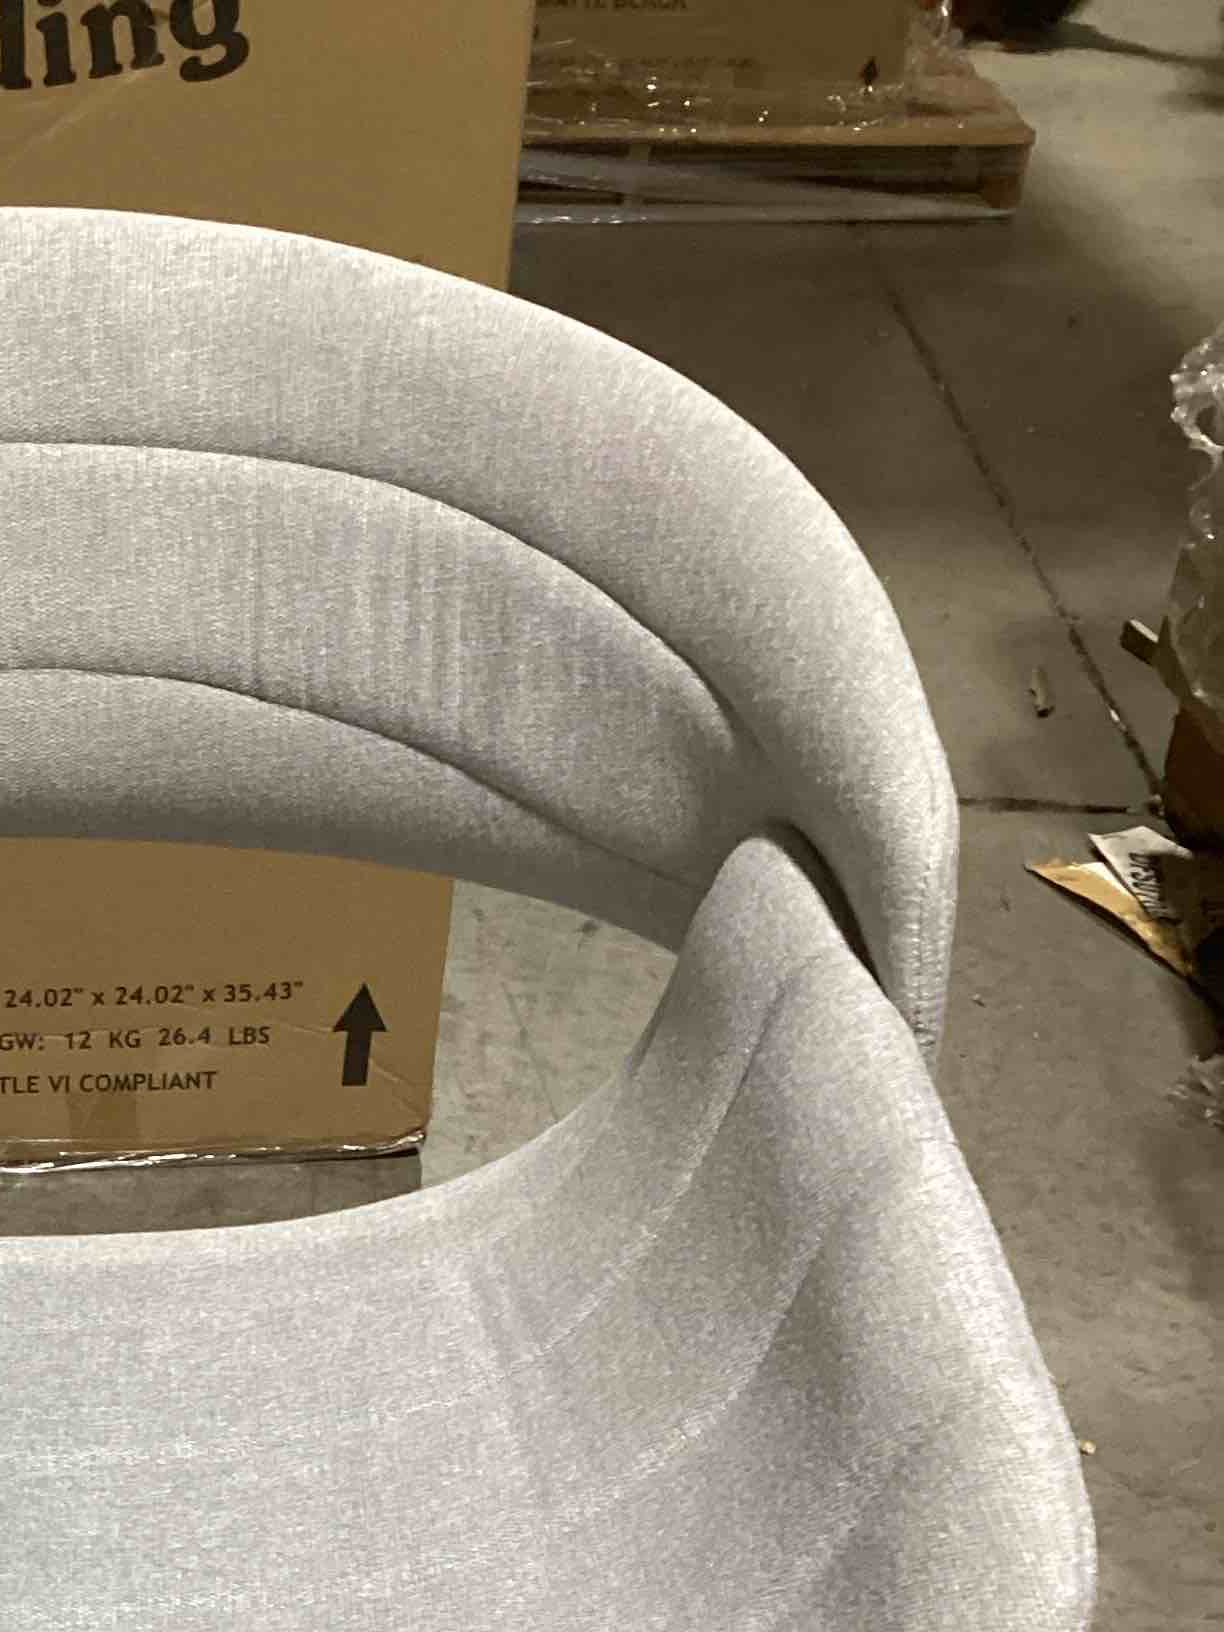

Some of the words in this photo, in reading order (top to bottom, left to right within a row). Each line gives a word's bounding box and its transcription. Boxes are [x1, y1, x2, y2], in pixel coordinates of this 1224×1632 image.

[4, 987, 84, 1008] 24.02"
[91, 990, 105, 1006] x
[115, 984, 195, 1005] 24.02"
[202, 987, 216, 1003] x
[223, 981, 304, 1003] 35.43"
[66, 1030, 92, 1050] 12
[109, 1029, 142, 1049] KG
[158, 1027, 212, 1046] 26.4
[228, 1025, 272, 1046] LBS
[48, 1074, 71, 1094] VI
[79, 1071, 219, 1094] COMPLIANT
